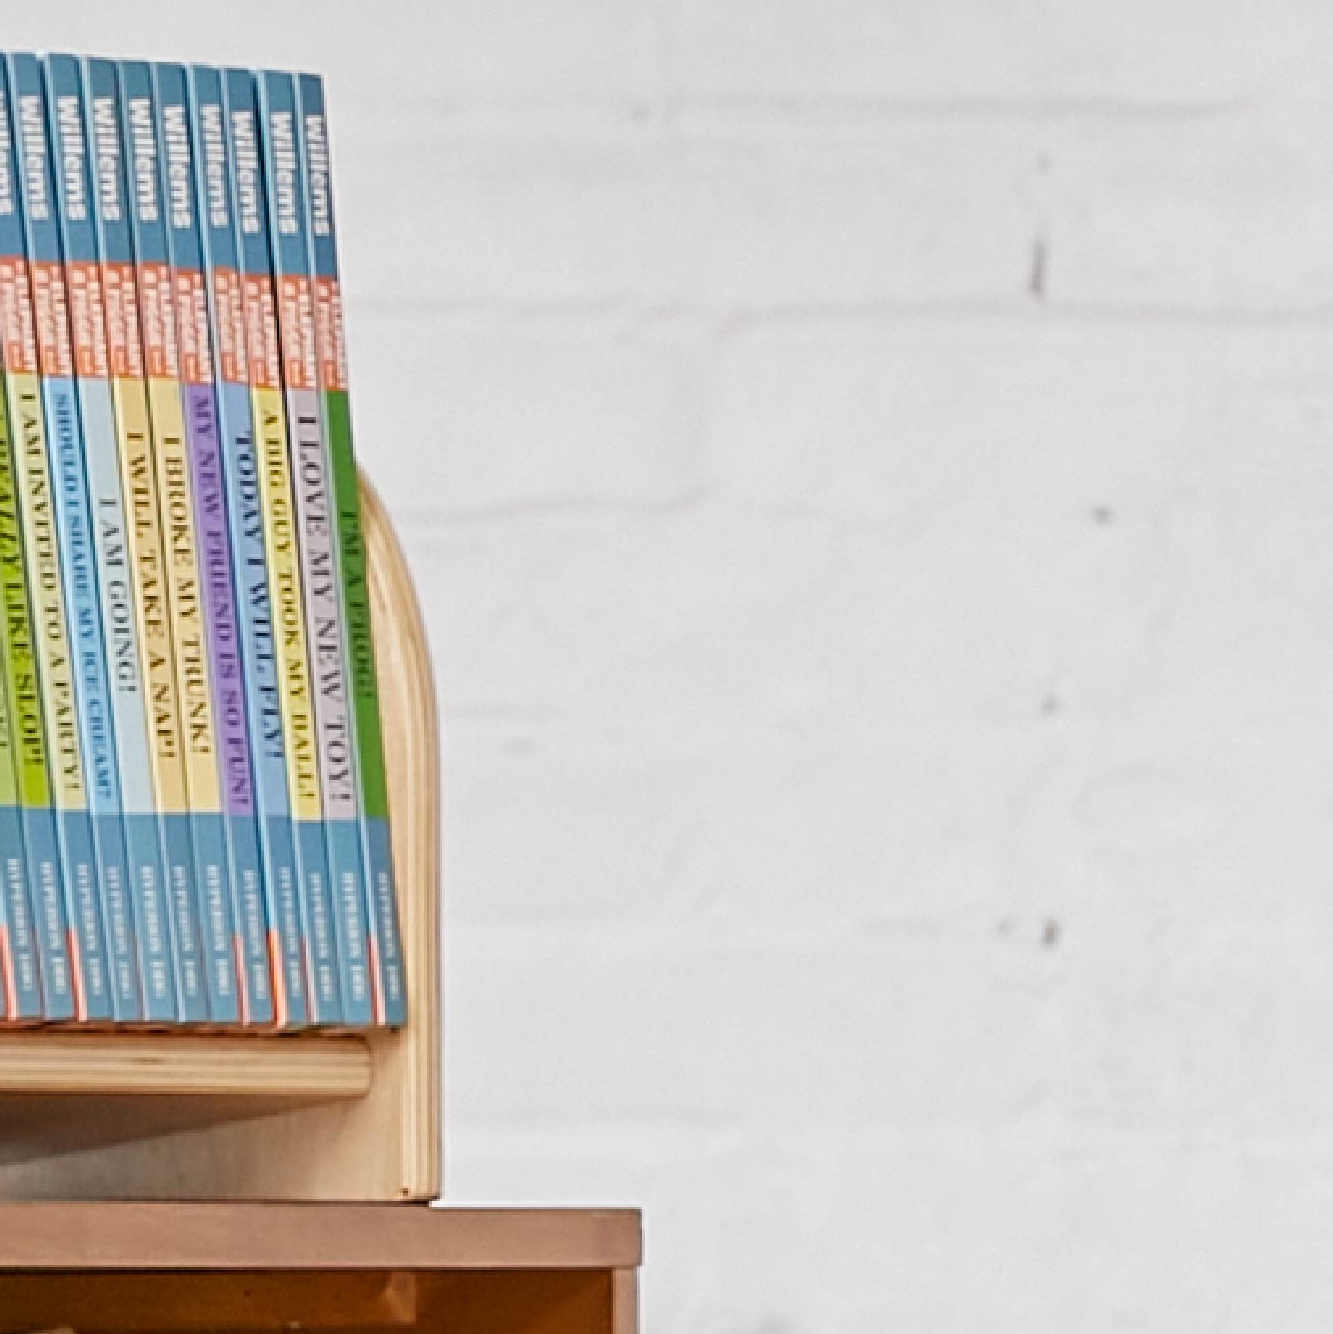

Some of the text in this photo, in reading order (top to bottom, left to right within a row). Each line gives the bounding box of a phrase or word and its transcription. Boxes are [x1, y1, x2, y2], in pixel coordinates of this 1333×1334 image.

[22, 415, 43, 457] AM
[265, 437, 285, 487] BIG
[127, 454, 154, 538] WILL
[162, 456, 192, 565] BROKE
[234, 431, 263, 540] TODAY
[270, 498, 291, 553] GUY
[299, 440, 328, 535] LOVE
[28, 468, 57, 590] INVITED
[100, 518, 124, 567] AM
[137, 548, 164, 638] TAKE
[175, 579, 198, 619] MY
[277, 572, 300, 647] TOOK
[309, 551, 334, 602] MY
[3, 581, 32, 661] LIKE
[43, 604, 63, 640] TO
[107, 580, 137, 693] GOING!
[248, 581, 275, 673] WILL
[315, 619, 342, 701] NEW
[180, 636, 211, 753] TRUNK!
[285, 658, 304, 697] MY
[14, 674, 43, 765] SLOP!
[52, 681, 79, 790] PARTY!
[151, 683, 176, 758] NAP!
[258, 686, 283, 759] FLY!
[290, 713, 313, 799] BALL!
[323, 716, 351, 800] TOY!
